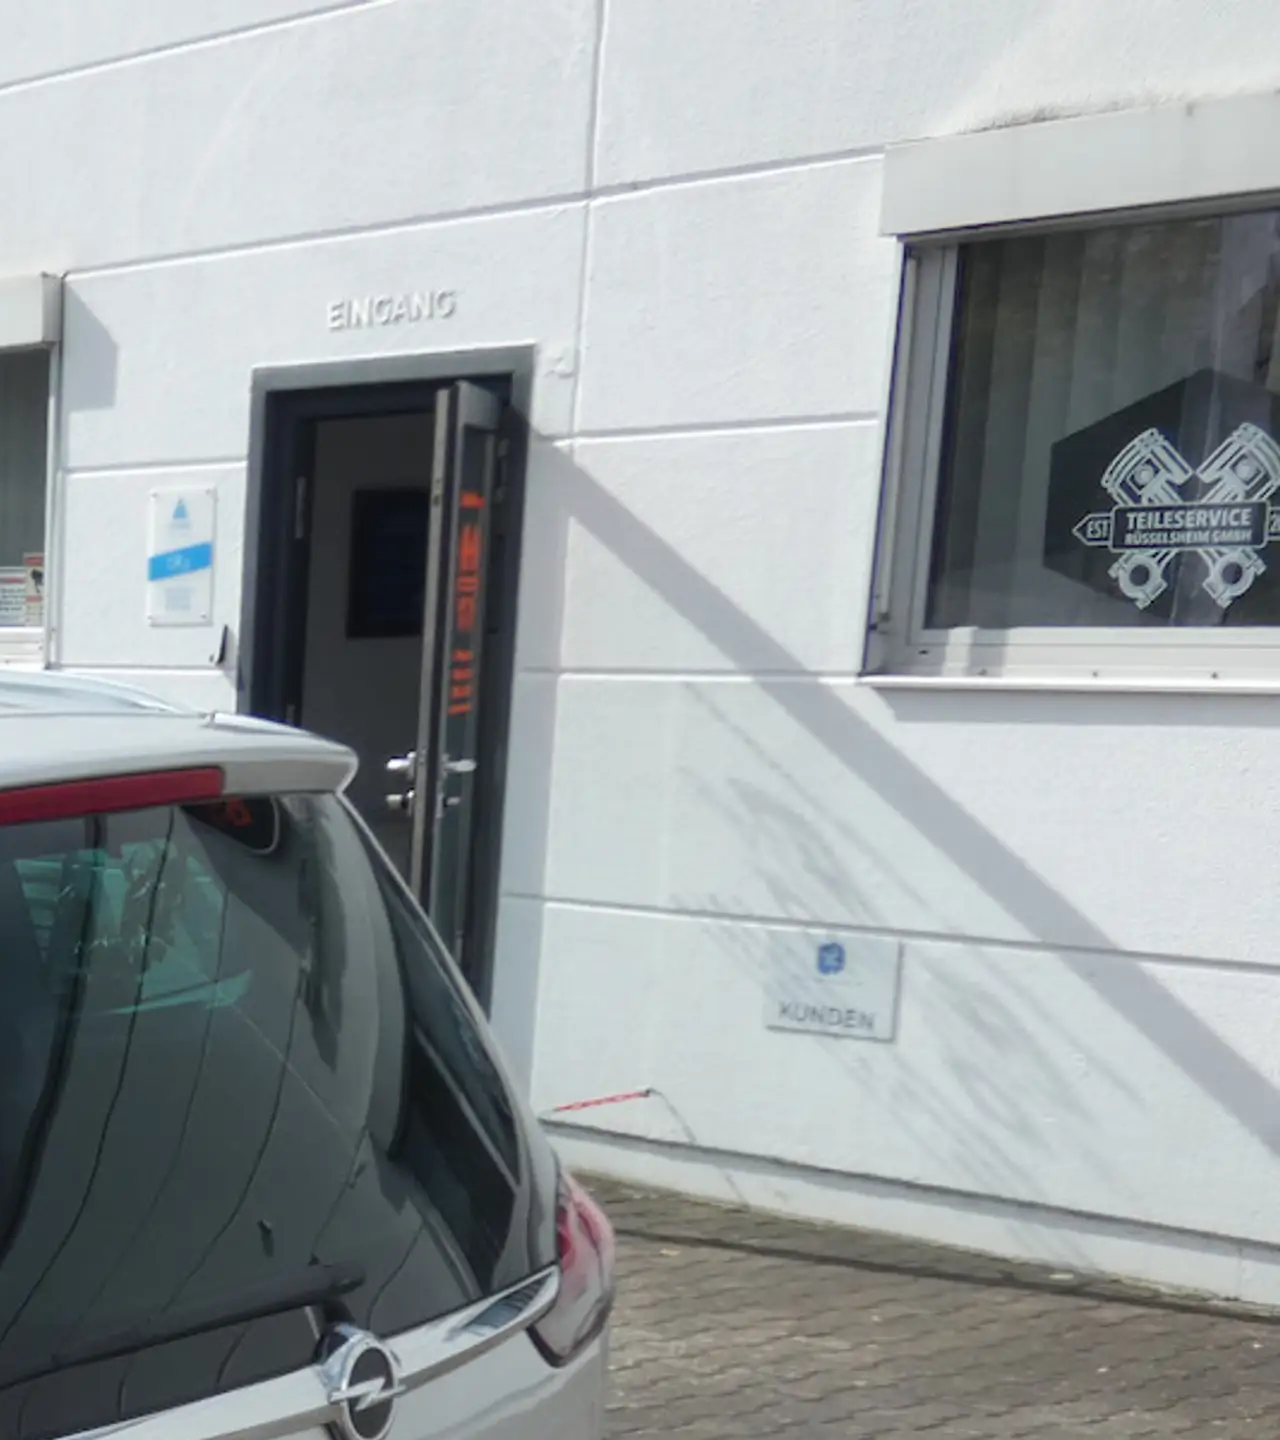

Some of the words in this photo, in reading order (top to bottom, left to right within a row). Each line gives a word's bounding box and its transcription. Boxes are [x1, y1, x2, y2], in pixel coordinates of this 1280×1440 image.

[327, 288, 457, 333] EINGANG
[1086, 519, 1110, 539] EST
[1126, 507, 1253, 530] TEILESERVICE
[779, 1000, 876, 1031] KUNDEN
